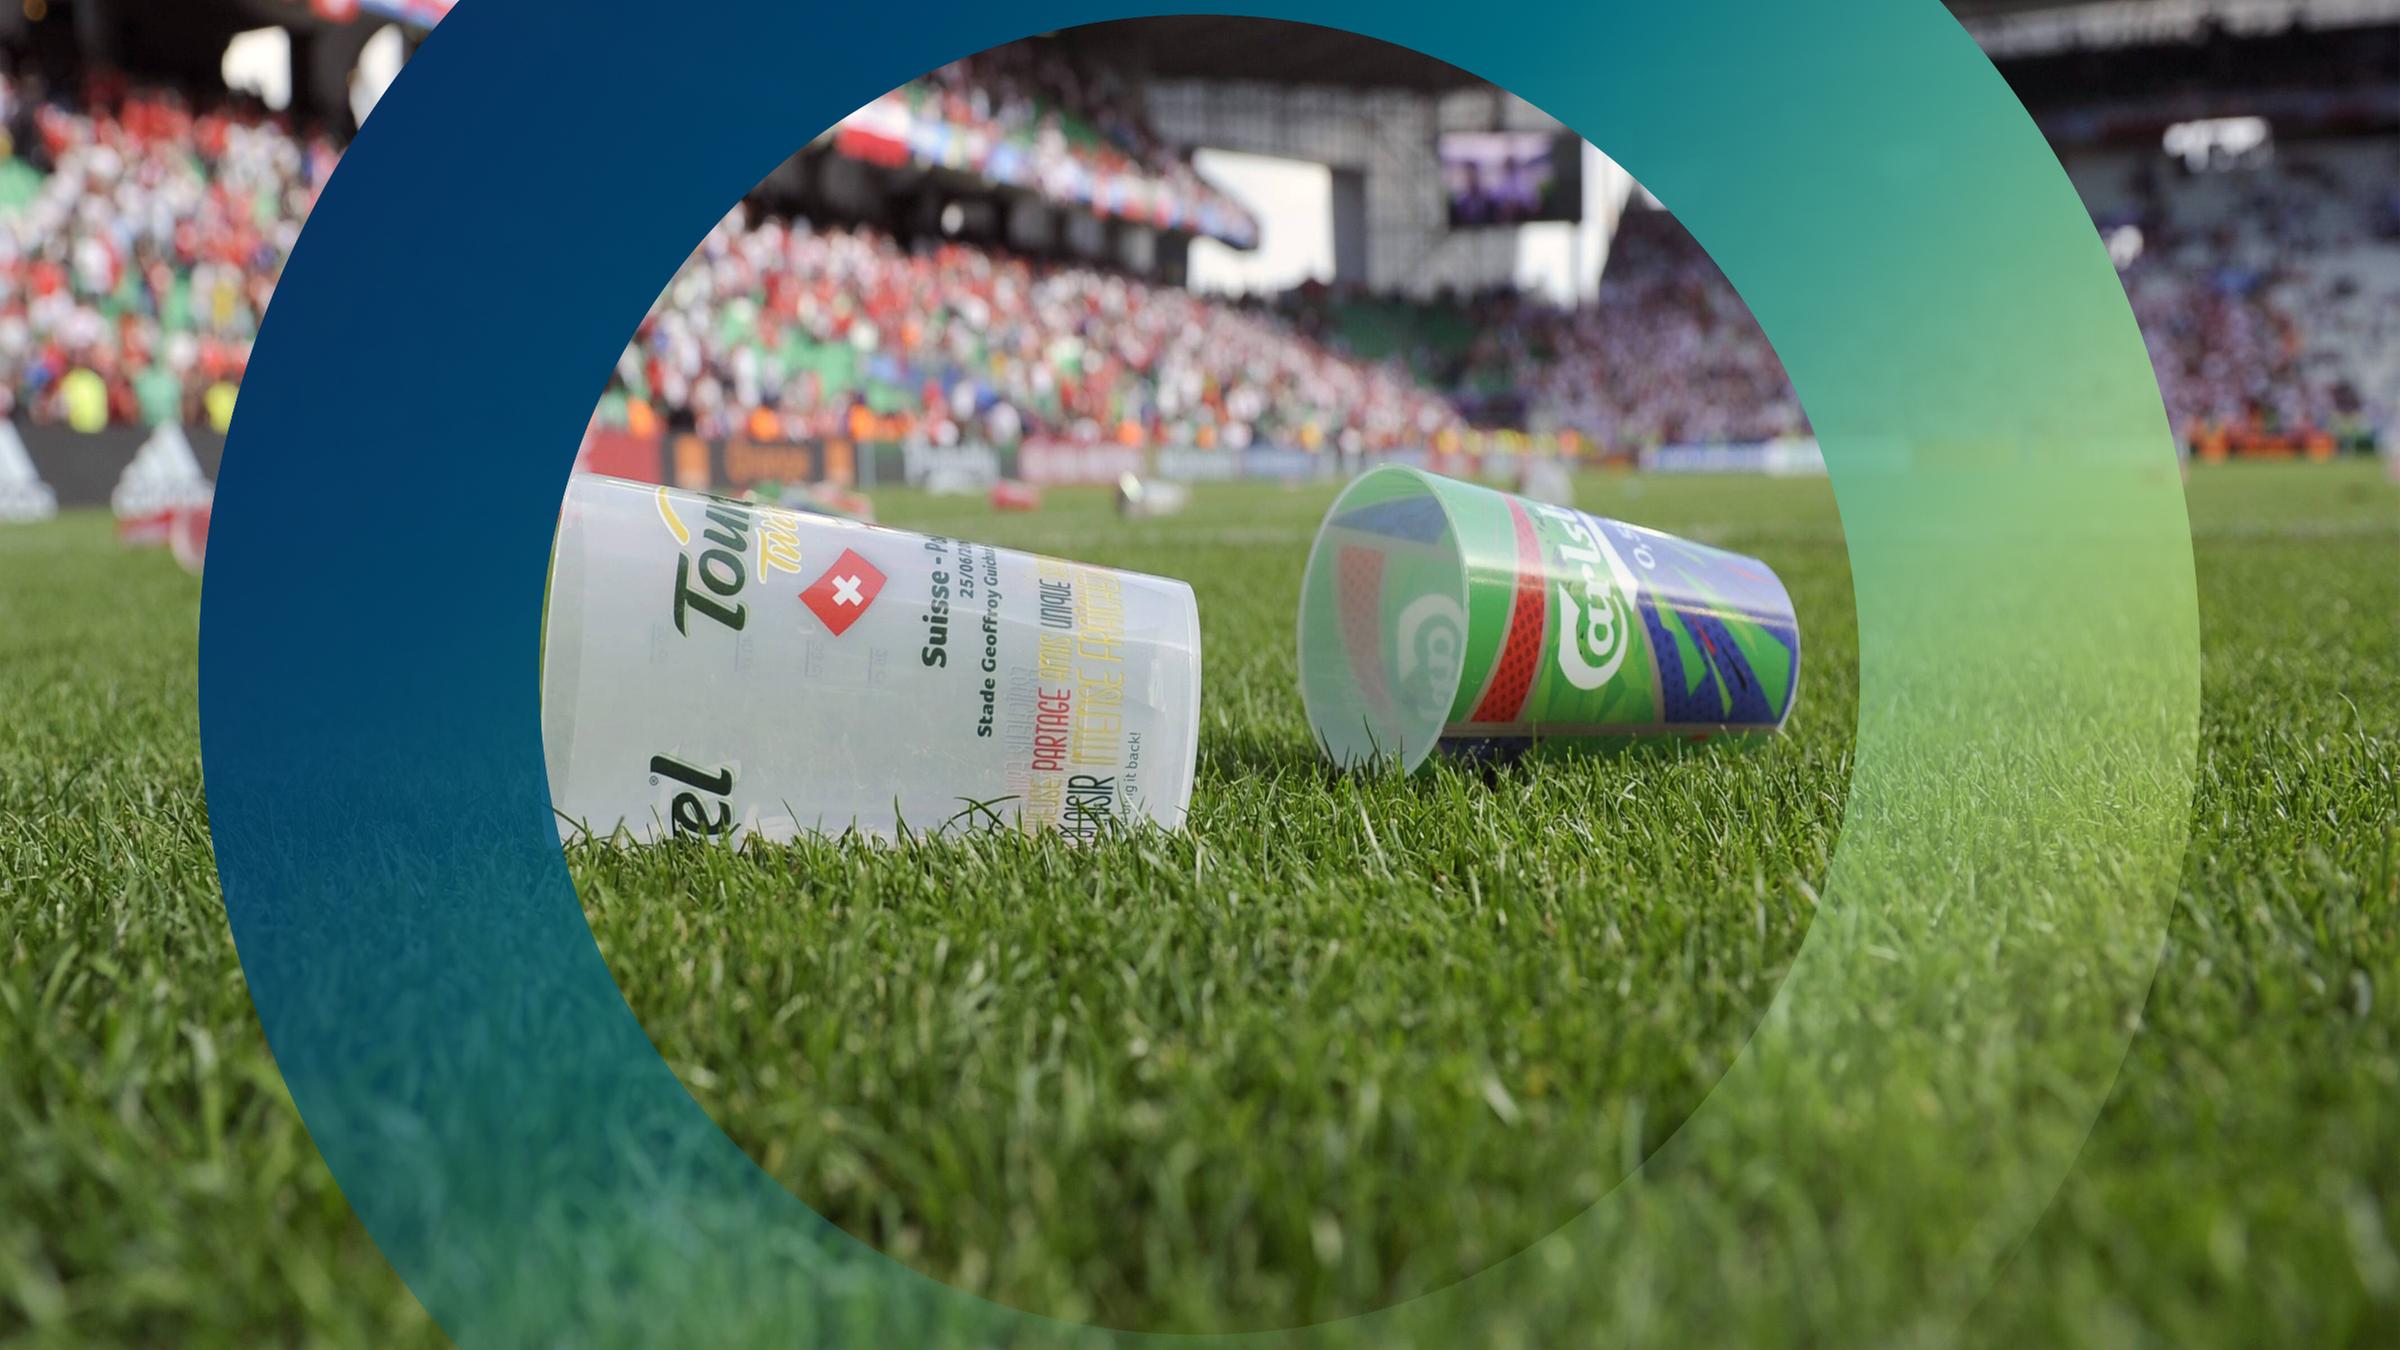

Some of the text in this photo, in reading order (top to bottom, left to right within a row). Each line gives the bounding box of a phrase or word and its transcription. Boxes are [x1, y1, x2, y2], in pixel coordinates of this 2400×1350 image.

[673, 493, 754, 638] Tour
[1040, 579, 1073, 629] UNIQUE
[921, 569, 950, 668] Suisse
[981, 590, 1003, 673] Geoffroy
[977, 678, 996, 738] Stade
[1032, 688, 1071, 771] PARTAGE
[1124, 772, 1136, 783] it
[1125, 732, 1142, 769] back!
[650, 755, 734, 839] el
